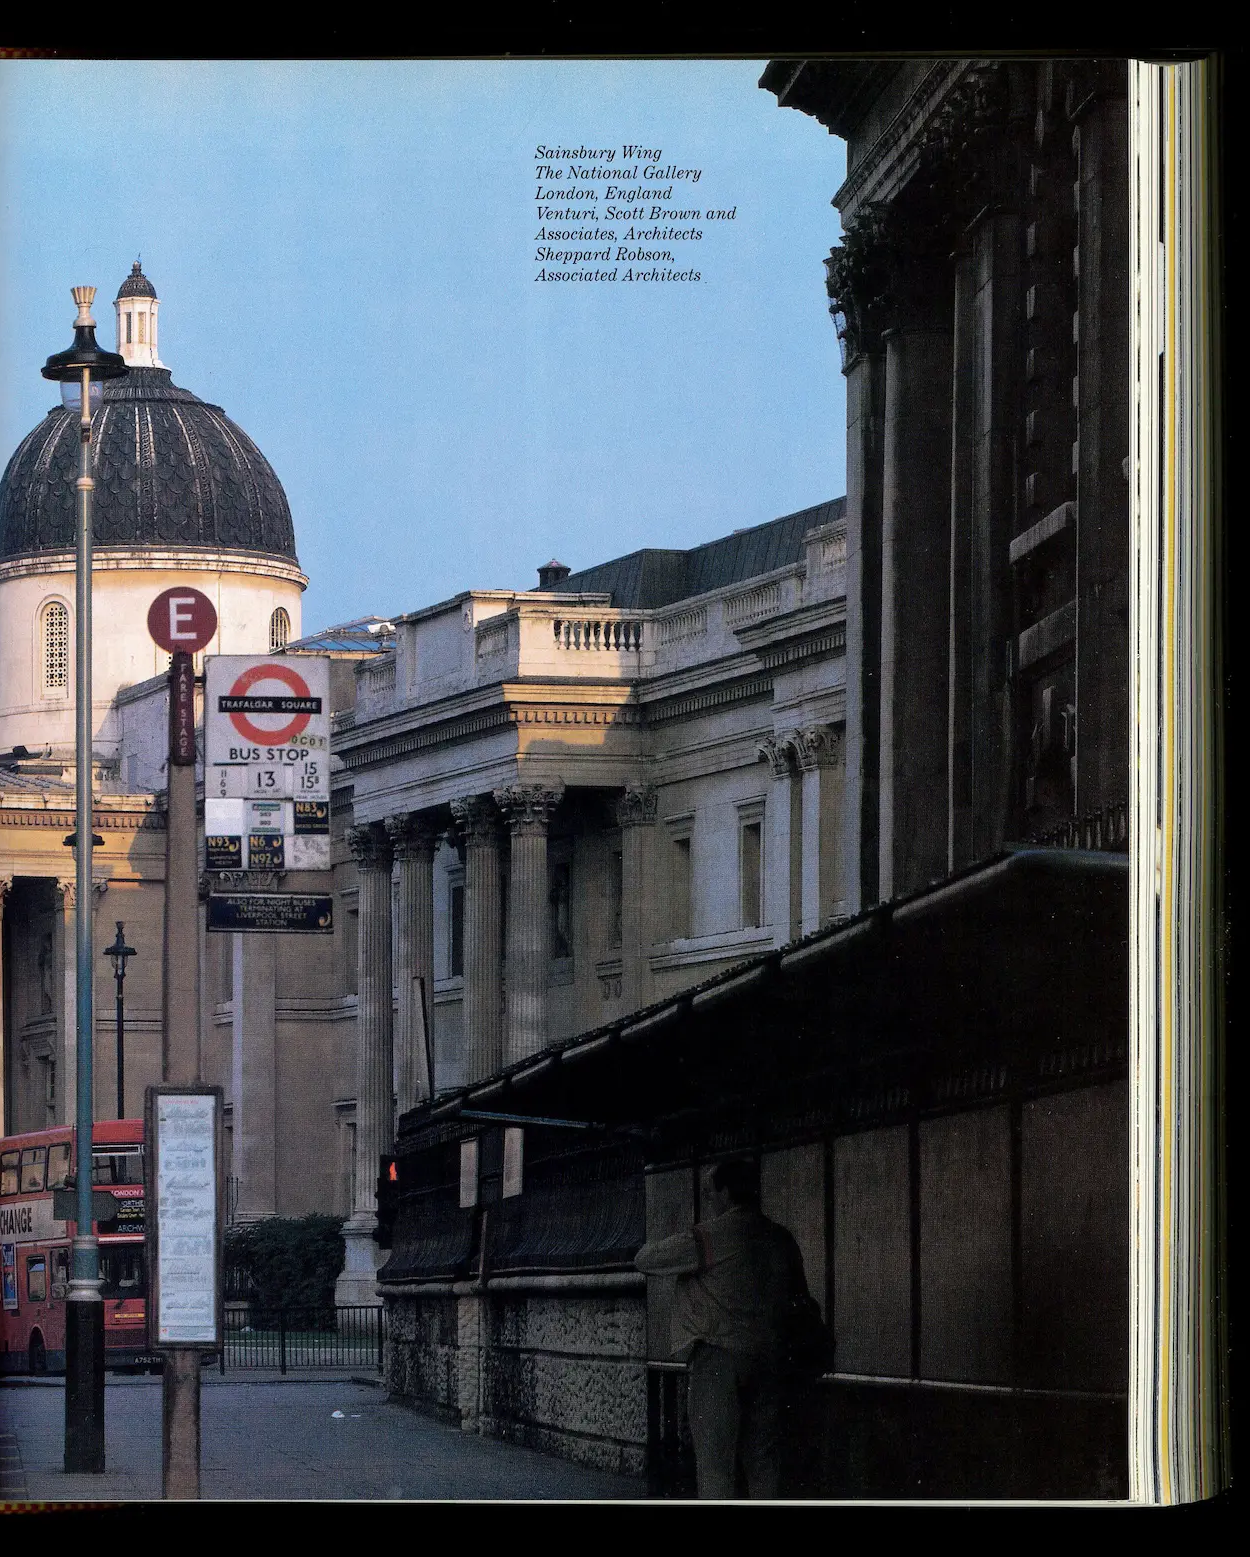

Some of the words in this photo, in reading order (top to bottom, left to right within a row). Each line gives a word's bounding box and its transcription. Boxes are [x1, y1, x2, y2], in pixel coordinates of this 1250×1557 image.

[169, 597, 197, 640] E
[179, 663, 188, 702] FARE
[221, 700, 274, 709] TRAFALGAR
[281, 701, 318, 710] SQUARE
[179, 708, 188, 757] STAGE
[230, 748, 260, 760] BUS
[267, 748, 309, 761] STOP
[304, 762, 317, 775] 15
[257, 771, 276, 787] 13
[220, 789, 227, 798] 9
[296, 802, 317, 813] N83
[208, 836, 230, 846] N93
[250, 836, 265, 847] N6
[251, 853, 271, 864] N92
